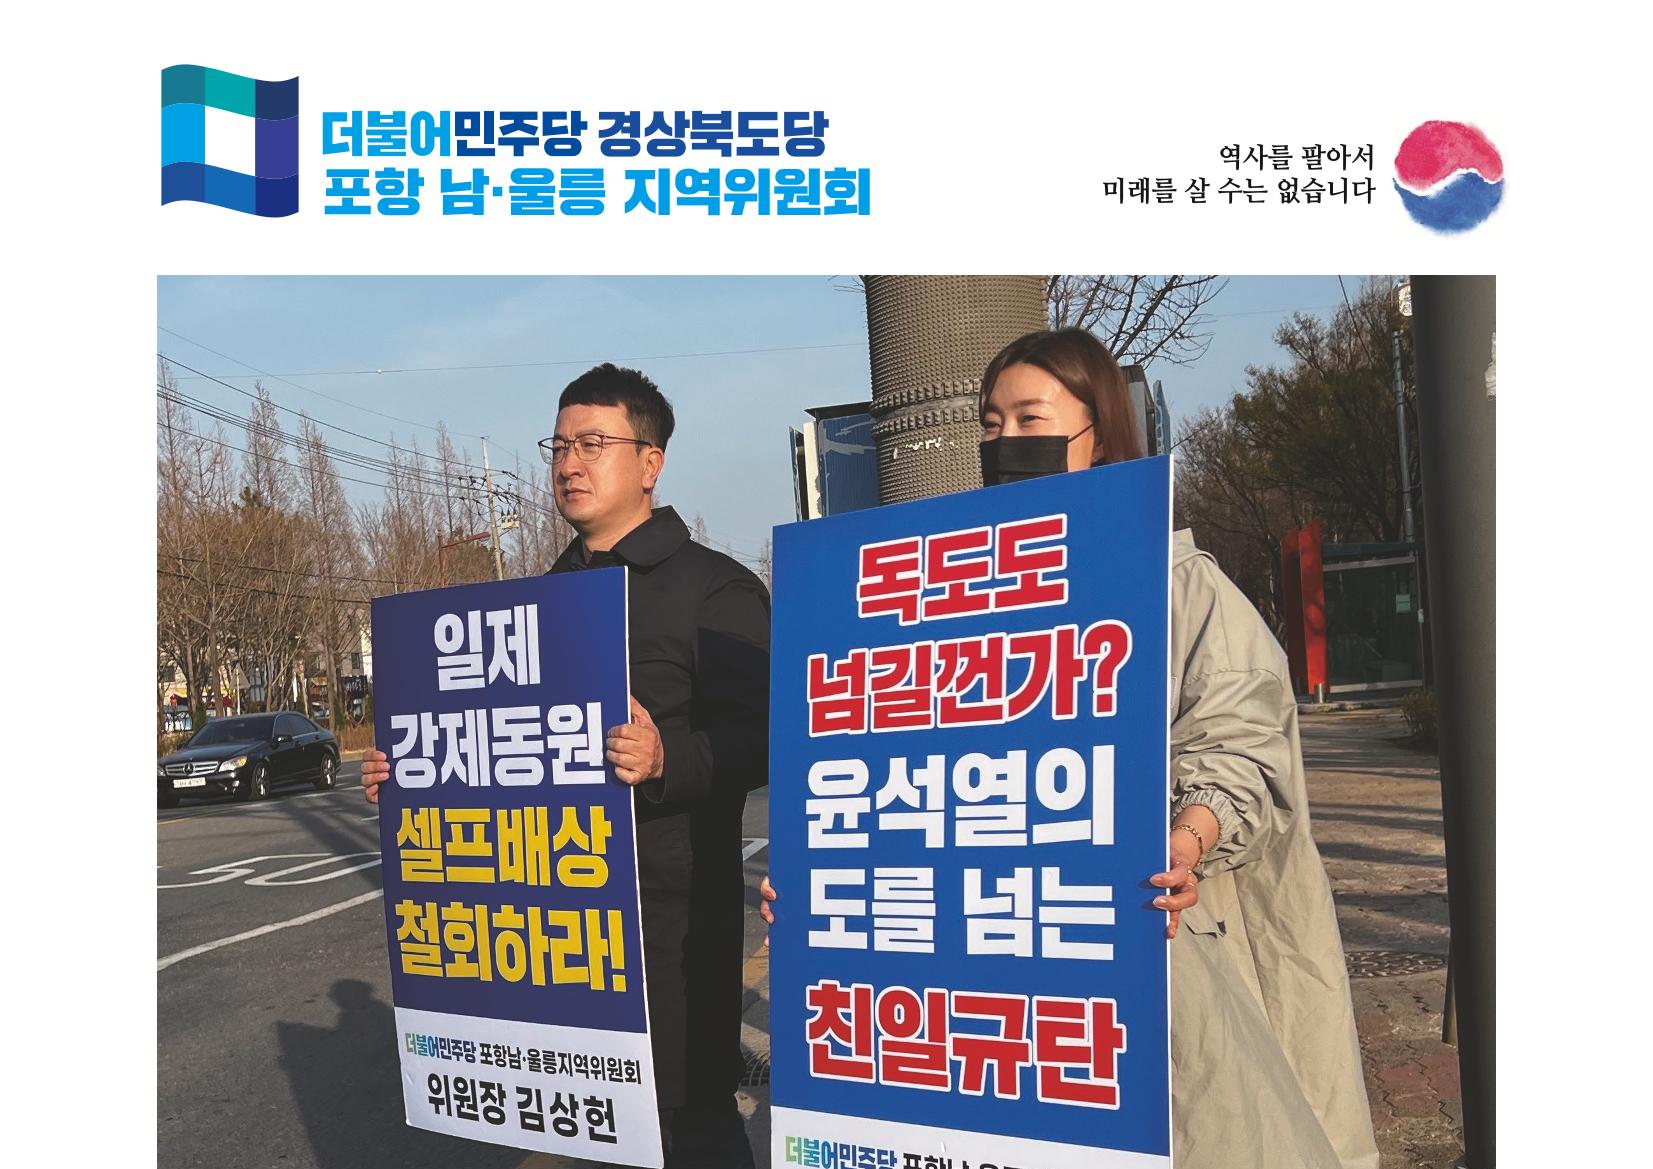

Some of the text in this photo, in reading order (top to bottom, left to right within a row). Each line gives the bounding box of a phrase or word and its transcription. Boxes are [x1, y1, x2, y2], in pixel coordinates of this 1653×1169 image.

[855, 513, 1069, 627] 독도도
[434, 603, 541, 691] 일제
[805, 620, 1133, 738] 넘길껀가?
[390, 702, 607, 789] 강제동원
[805, 744, 1116, 850] 윤석열의
[396, 806, 613, 889] 셀프배상
[394, 899, 628, 993] 철회하라!
[808, 866, 1115, 961] 도를 넘는
[405, 1033, 642, 1085] 더불어민주당 포항남·울릉지역위원회
[805, 979, 1128, 1111] 친일규탄
[427, 1072, 618, 1144] 위원장 김상헌
